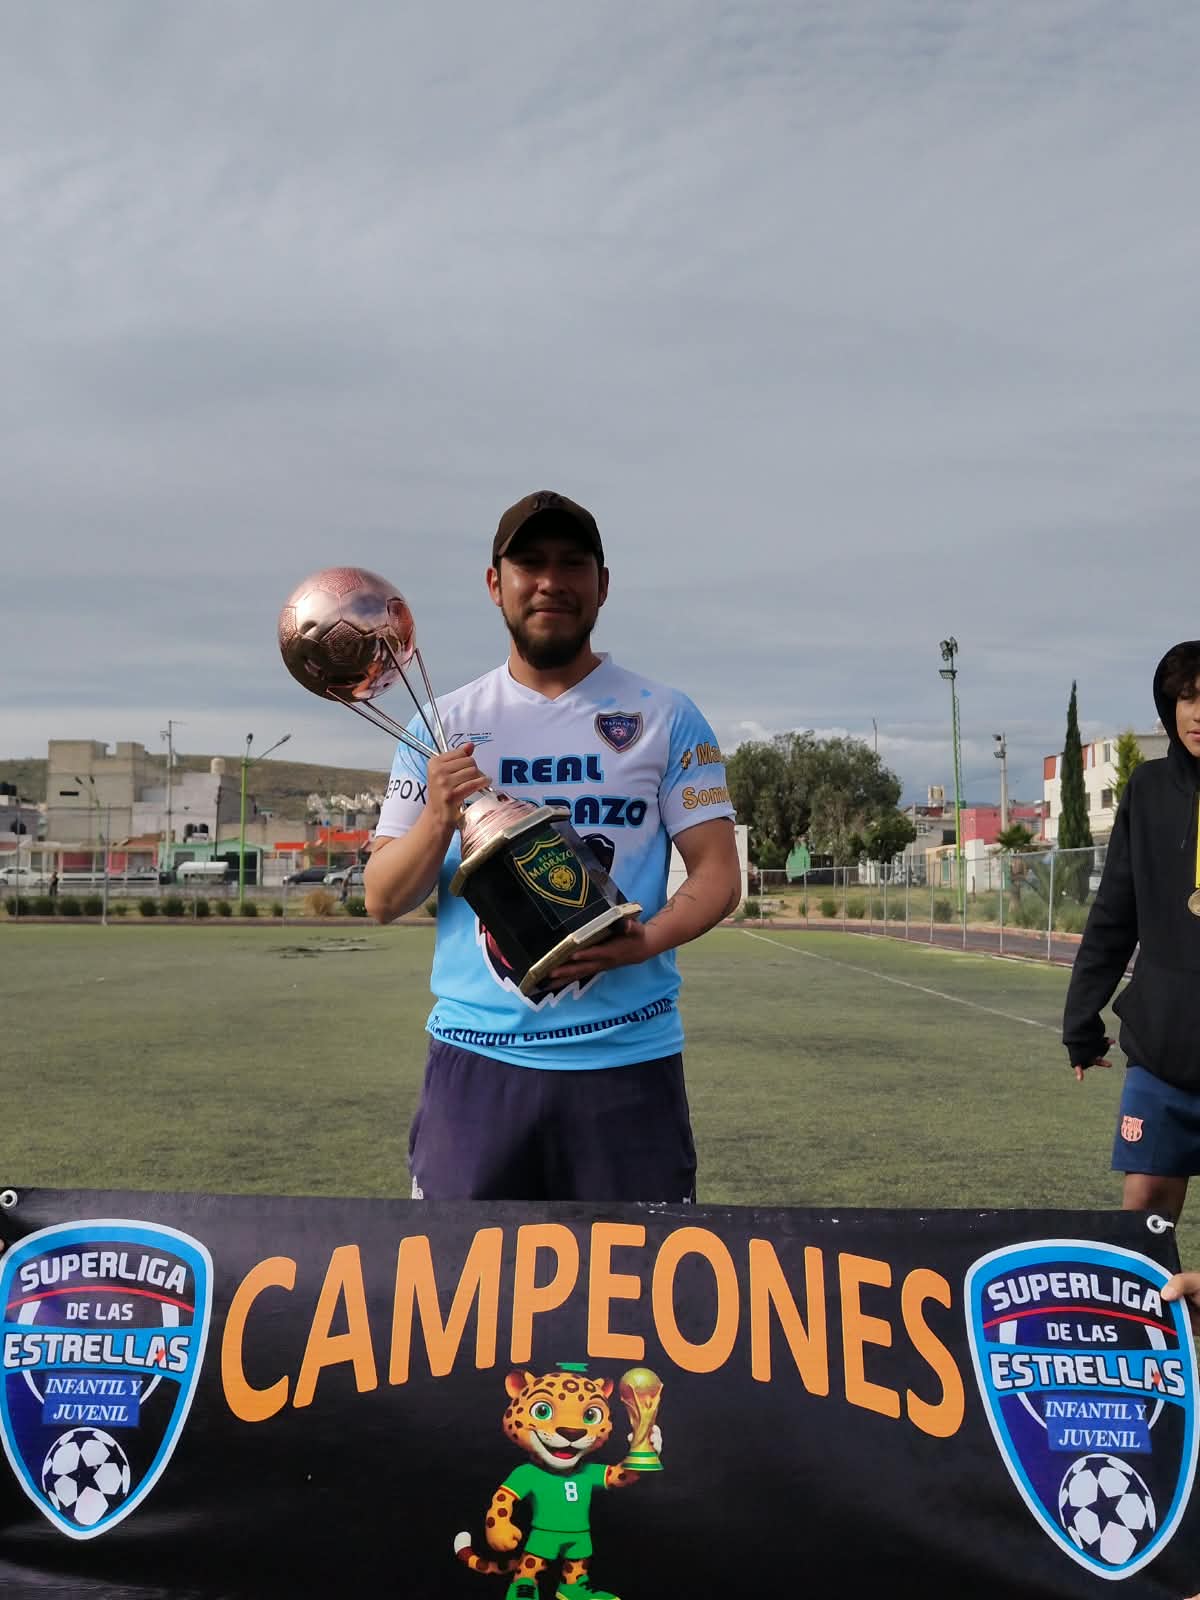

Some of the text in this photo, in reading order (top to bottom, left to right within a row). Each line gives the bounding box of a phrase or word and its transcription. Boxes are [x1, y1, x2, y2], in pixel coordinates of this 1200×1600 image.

[501, 754, 604, 785] REAL
[19, 1251, 187, 1294] SUPERLIGA
[987, 1272, 1163, 1317] SUPERLIGA
[66, 1302, 133, 1320] DE LAS
[222, 1222, 965, 1438] CAMPEONES
[1046, 1322, 1118, 1342] DE LAS
[3, 1333, 190, 1372] ESTRELLAS
[989, 1353, 1186, 1397] ESTRELLAS
[45, 1378, 143, 1395] INFANTIL Y
[53, 1404, 129, 1421] JUVENIL
[1045, 1401, 1147, 1421] INFANTIL Y
[1059, 1430, 1140, 1448] JUVENIL
[564, 1481, 578, 1502] 8
